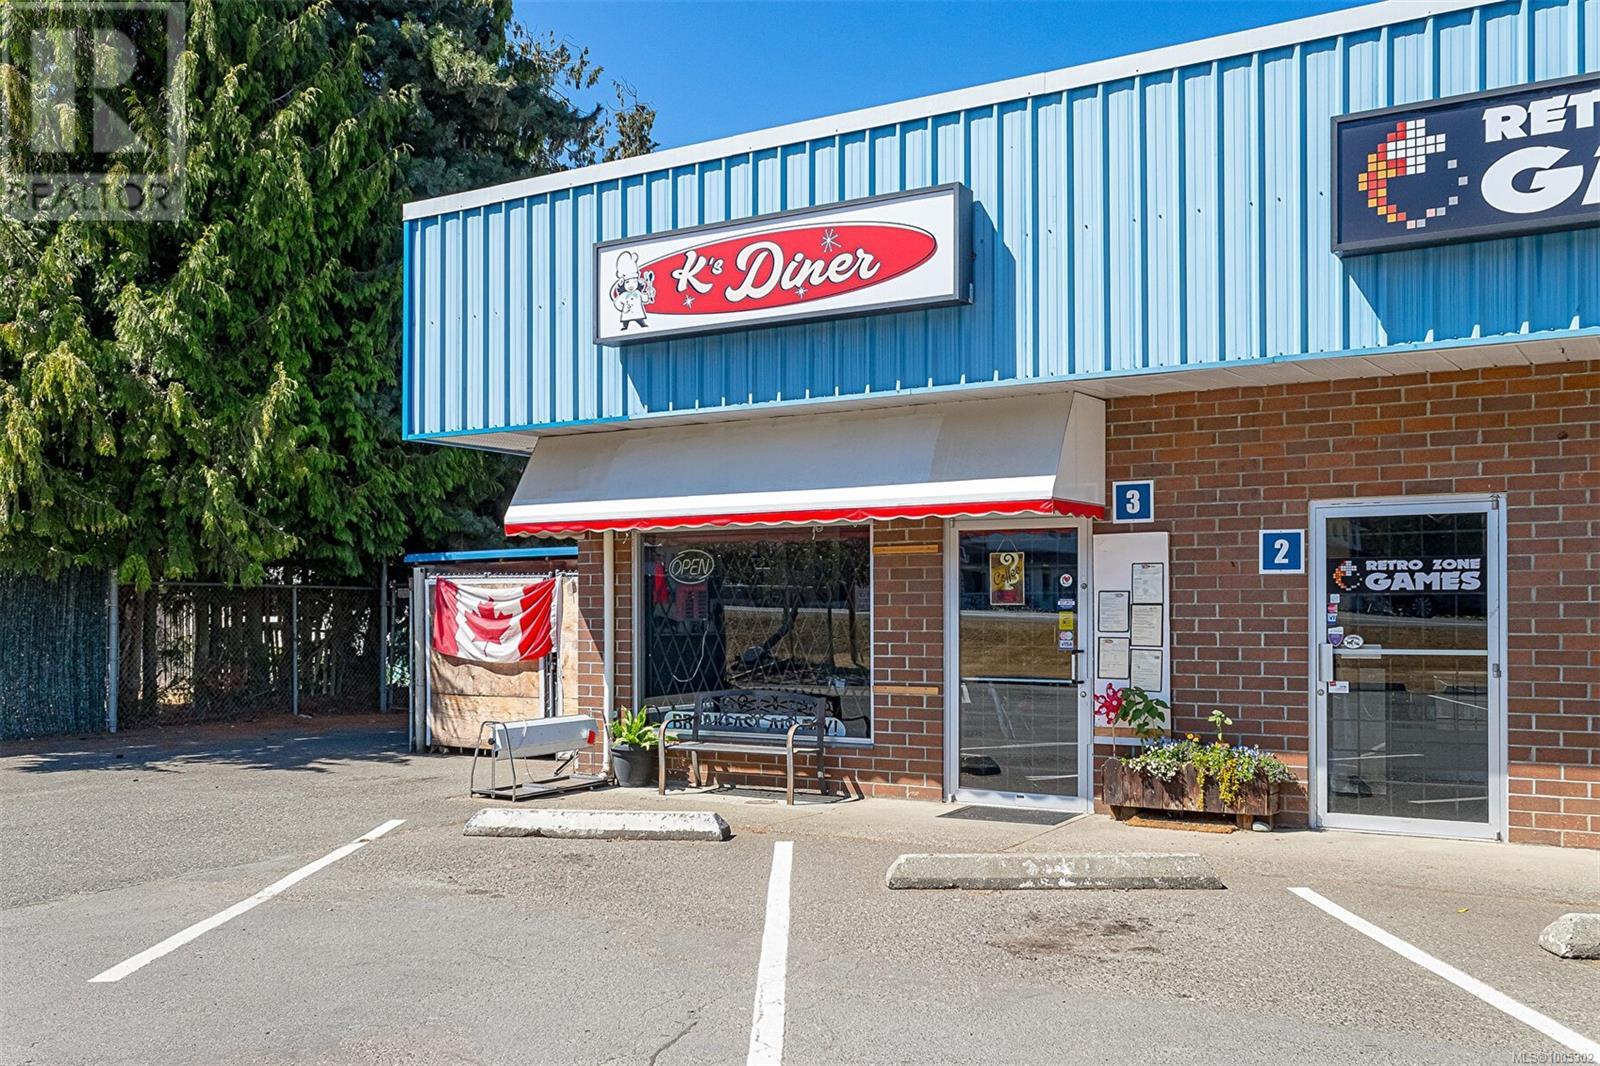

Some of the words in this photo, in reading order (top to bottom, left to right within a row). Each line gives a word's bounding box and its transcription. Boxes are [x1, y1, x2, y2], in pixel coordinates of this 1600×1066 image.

[1481, 145, 1600, 214] G
[672, 250, 723, 294] K's
[725, 241, 881, 303] Diner
[1126, 489, 1141, 514] 3
[1274, 539, 1290, 564] 2
[671, 559, 710, 575] OPEN
[1365, 559, 1424, 570] RETRO
[1432, 558, 1481, 570] ZONE
[1365, 571, 1481, 591] GAMES
[672, 713, 762, 731] BRAKFAST
